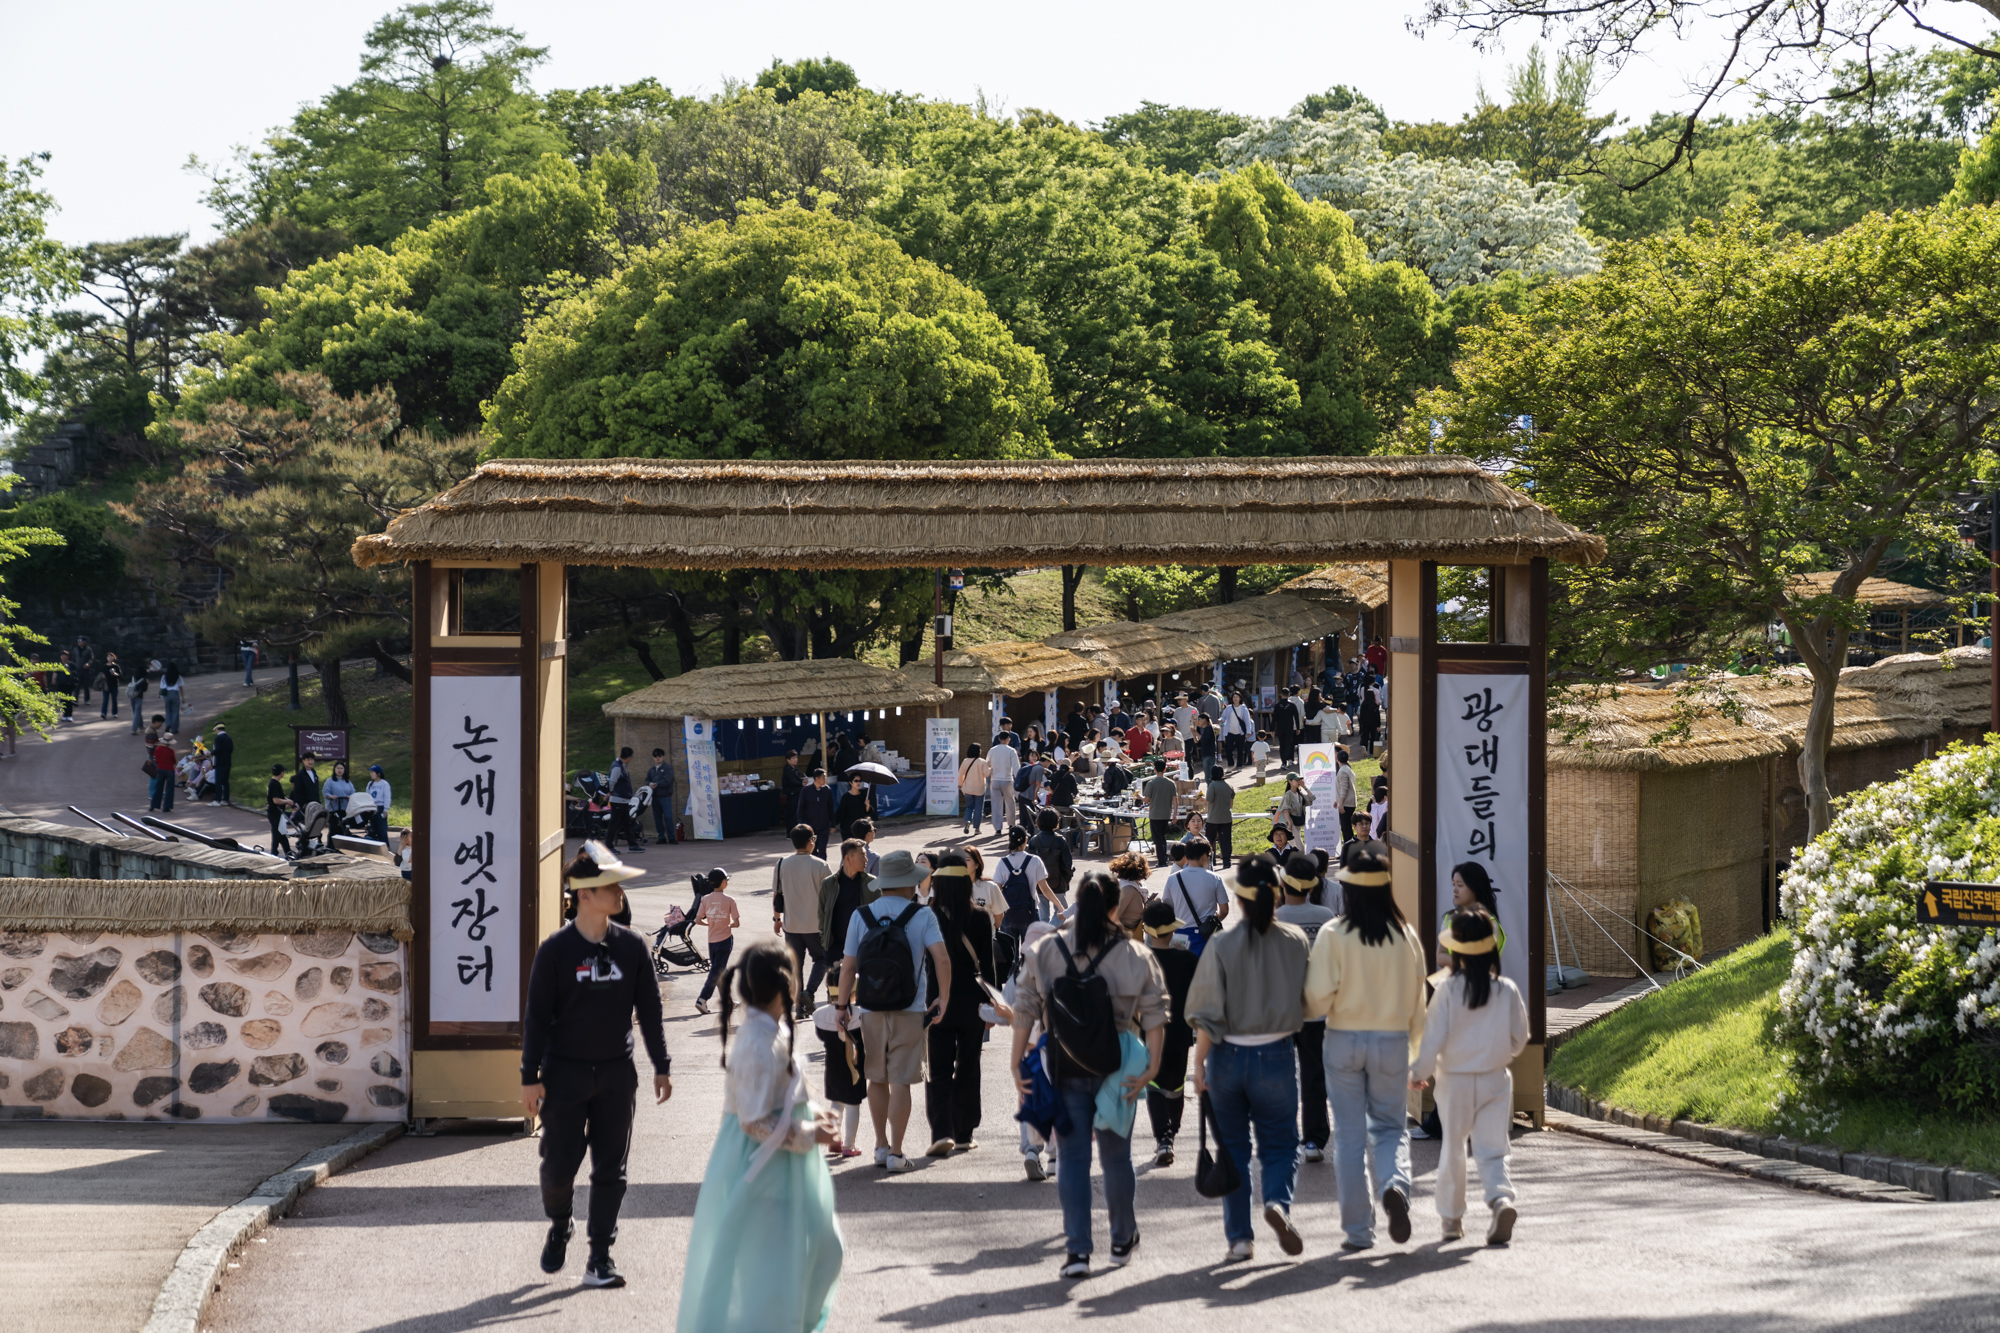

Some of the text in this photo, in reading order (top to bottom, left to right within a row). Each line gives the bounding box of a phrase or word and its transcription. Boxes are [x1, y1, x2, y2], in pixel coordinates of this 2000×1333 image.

[451, 715, 500, 992] 논개 옛장터
[1460, 686, 1504, 861] 광대들의
[576, 964, 622, 982] FILA
